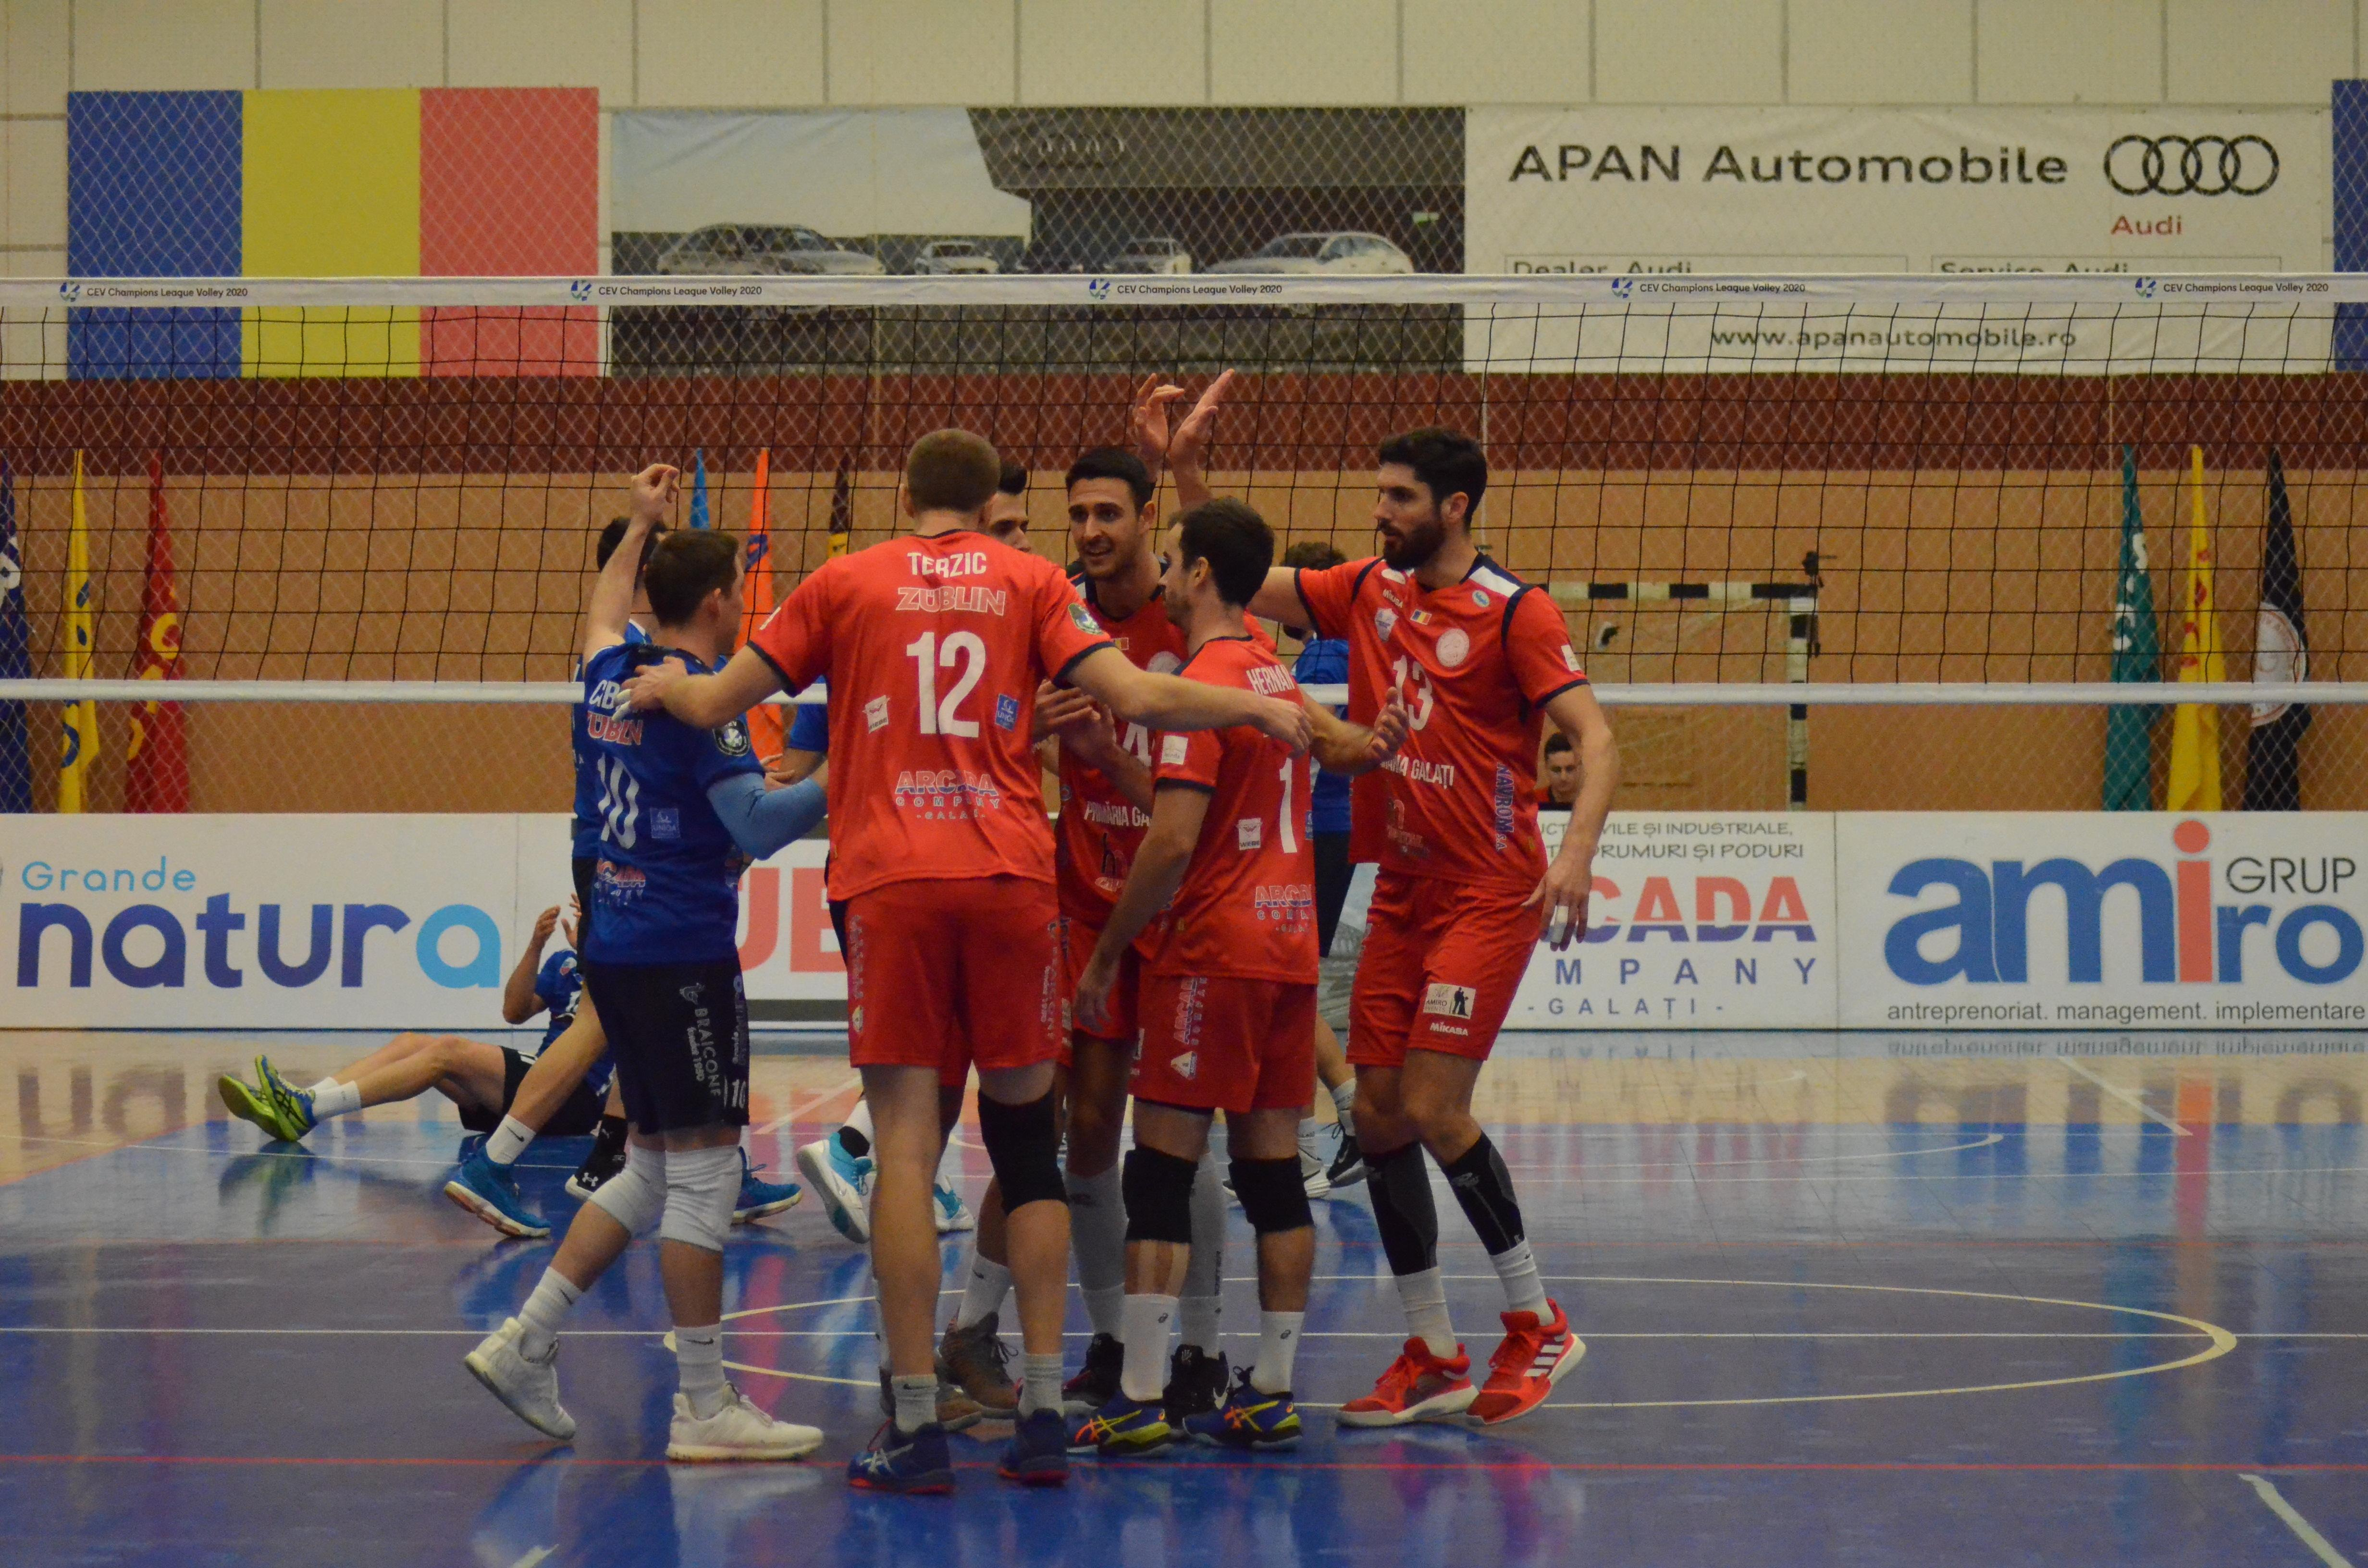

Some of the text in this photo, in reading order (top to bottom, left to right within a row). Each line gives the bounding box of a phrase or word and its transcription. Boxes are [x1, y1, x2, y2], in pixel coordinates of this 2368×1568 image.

[1508, 145, 2067, 183] APAN Automobile
[2110, 215, 2182, 235] Audi
[87, 288, 248, 298] CEV Champions League Volley 2020
[599, 286, 762, 297] CEV Champions League Volley 2020
[1117, 285, 1282, 295] CEV Champions League Volley 2020
[1640, 283, 1805, 294] CEV Champions League Volley 2020
[2163, 283, 2183, 292] CEV
[2185, 283, 2237, 293] Champions
[2240, 283, 2273, 294] League
[2275, 283, 2303, 294] Volley
[1711, 328, 2076, 350] www.apanautomobile.ro
[907, 552, 987, 578] TERZIC
[896, 586, 1006, 616] ZÜBLIN
[906, 631, 986, 738] 12
[1666, 822, 1793, 836] INDUSTRIALE,
[1596, 844, 1686, 858] RUMURI
[1721, 844, 1803, 858] PODURI
[21, 856, 197, 892] Grande
[2225, 857, 2356, 894] GRUP
[1583, 876, 1817, 943] CADA
[17, 893, 501, 989] natura
[1555, 958, 1816, 985] MPANY
[1887, 1001, 2365, 1025] antreprenoriat. management. implementare
